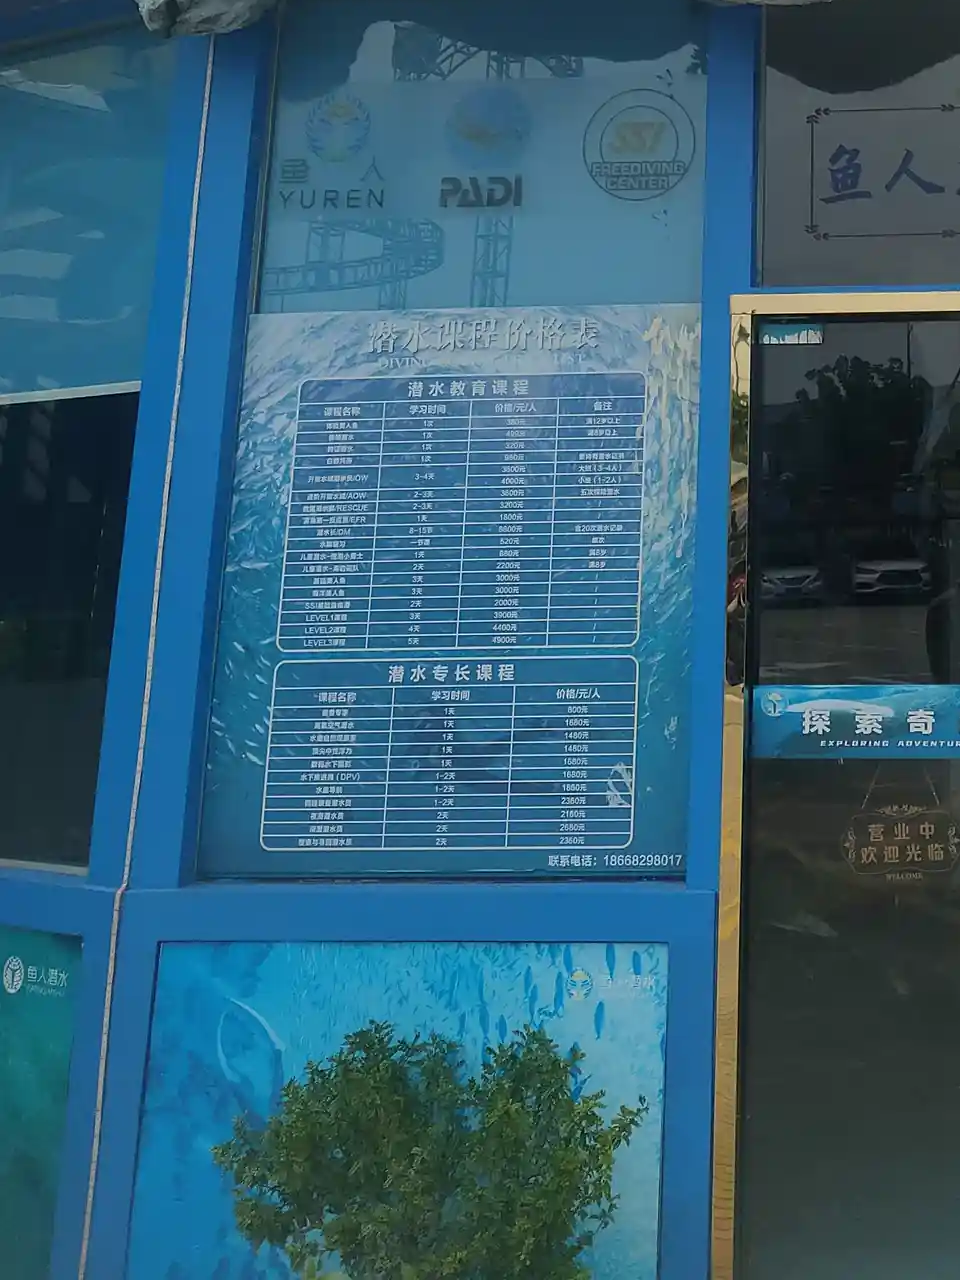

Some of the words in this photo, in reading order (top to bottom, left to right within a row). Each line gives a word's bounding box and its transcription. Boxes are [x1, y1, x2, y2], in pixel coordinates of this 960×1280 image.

[591, 161, 685, 176] FREEDIVING
[606, 176, 669, 190] CENTER
[439, 174, 523, 207] PADI
[279, 188, 385, 209] YUREN
[368, 318, 600, 354] 潜水课程价格表
[380, 356, 430, 369] DIVIN
[408, 380, 529, 398] 潜水教育课程
[409, 404, 447, 415] 学习时间
[388, 664, 516, 683] 潜水专长课程
[432, 690, 470, 701] 学习时间
[556, 688, 600, 699] 价格/元/人
[443, 720, 455, 728] 1天
[442, 733, 454, 741] 1天
[442, 746, 453, 754] 1天
[441, 760, 452, 768] 1天
[434, 799, 454, 807] 1-2天
[437, 812, 449, 820] 2天
[436, 825, 448, 833] 2天
[868, 821, 935, 842] 营业中
[435, 838, 447, 846] 2天
[860, 843, 944, 864] 欢迎光临
